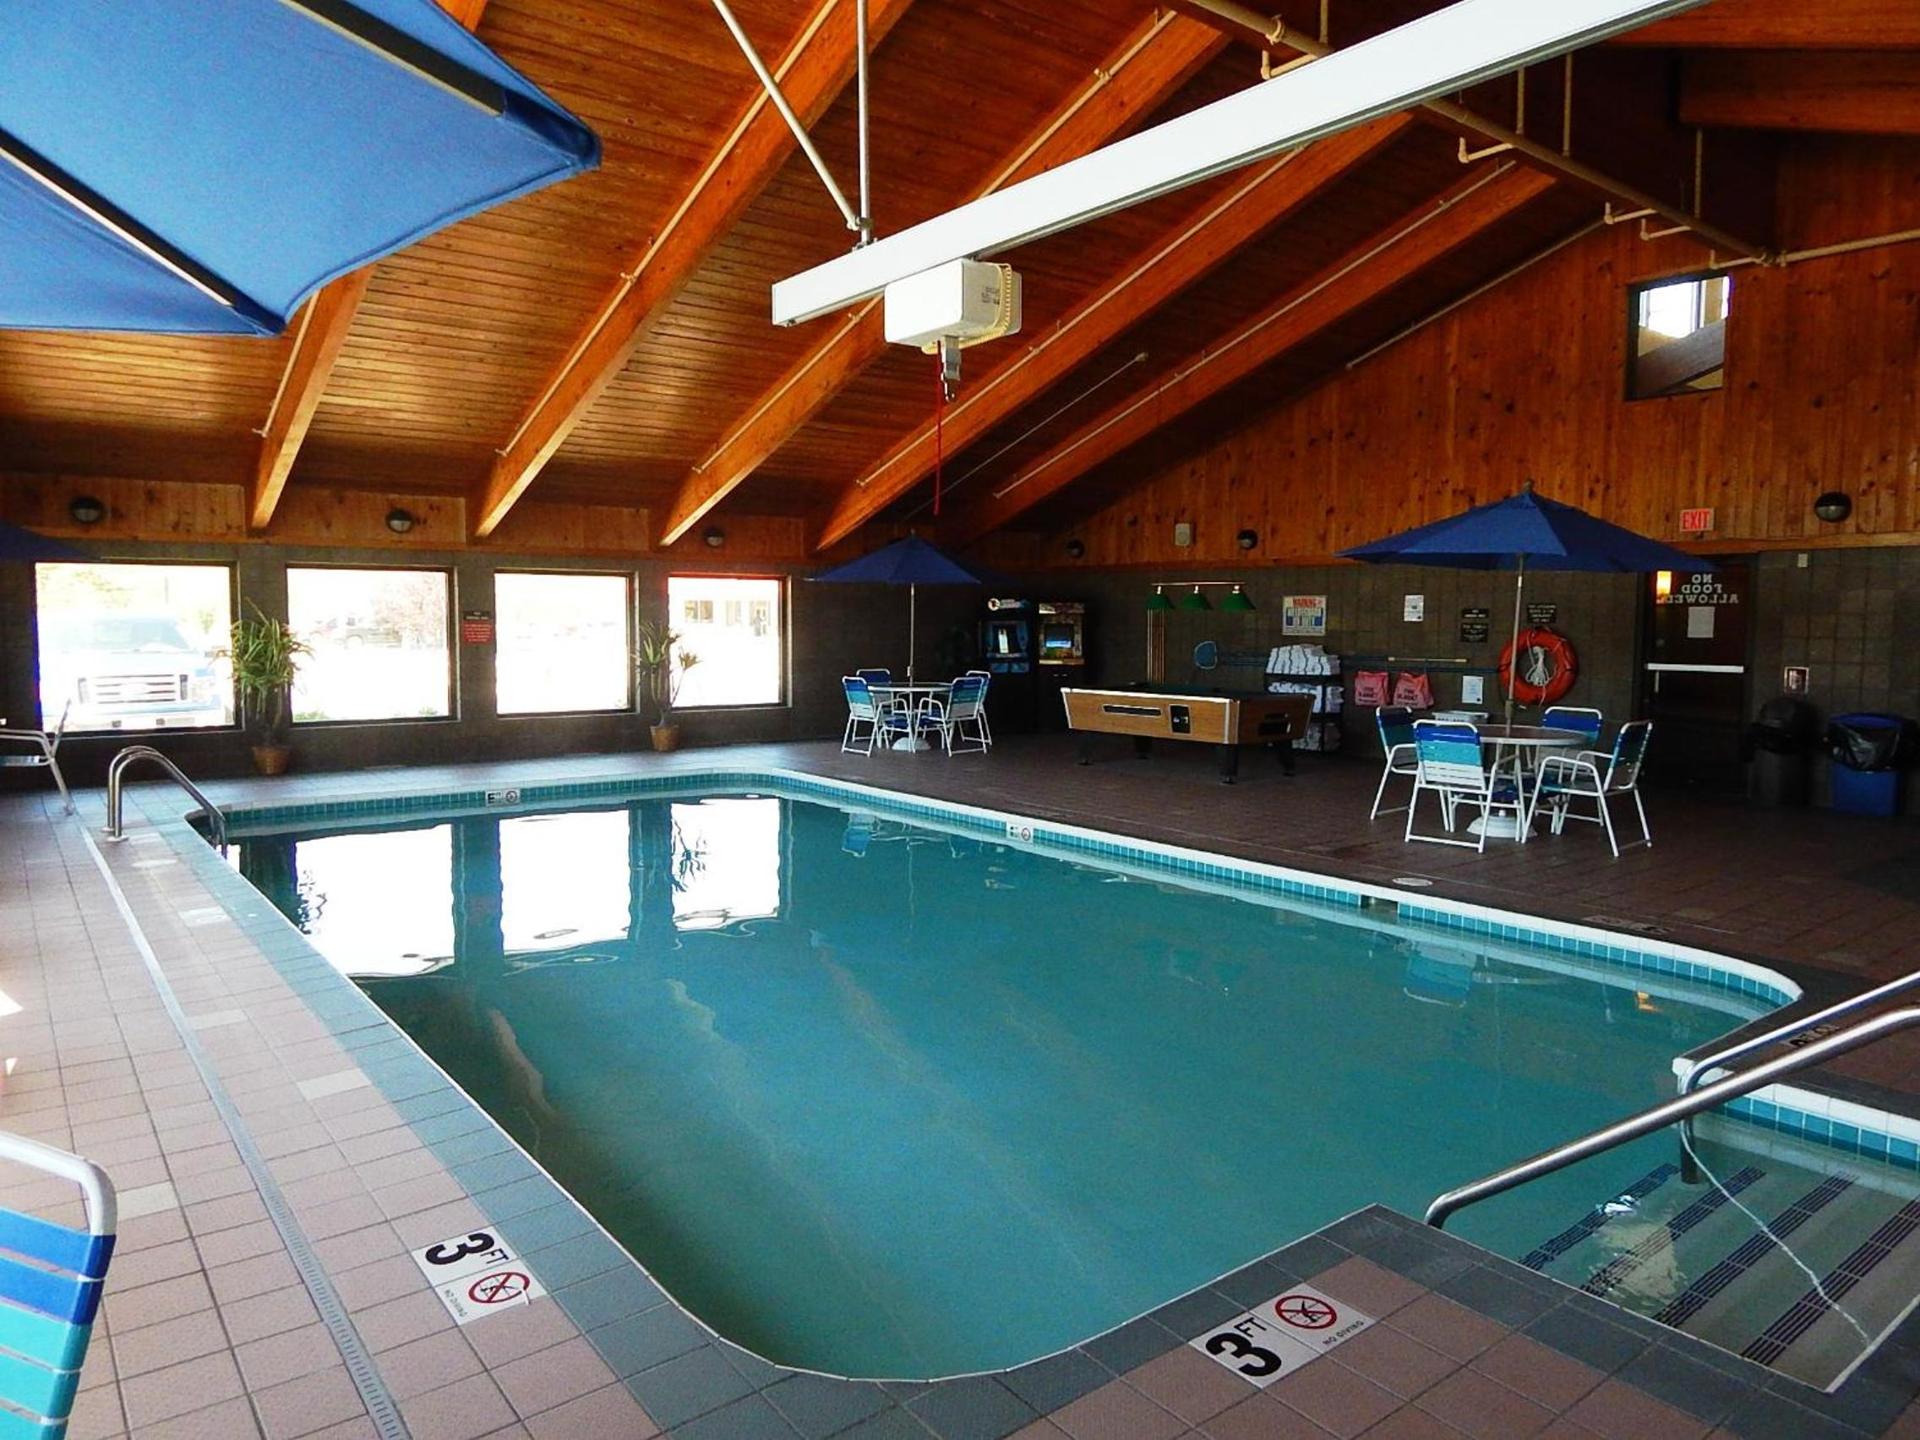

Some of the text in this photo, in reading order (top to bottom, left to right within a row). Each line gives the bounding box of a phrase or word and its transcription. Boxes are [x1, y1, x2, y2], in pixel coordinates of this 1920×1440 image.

[1683, 511, 1710, 529] EXIT
[425, 1233, 510, 1265] 3 FT
[1205, 1317, 1282, 1377] 3 FT
[1322, 1336, 1337, 1346] NO
